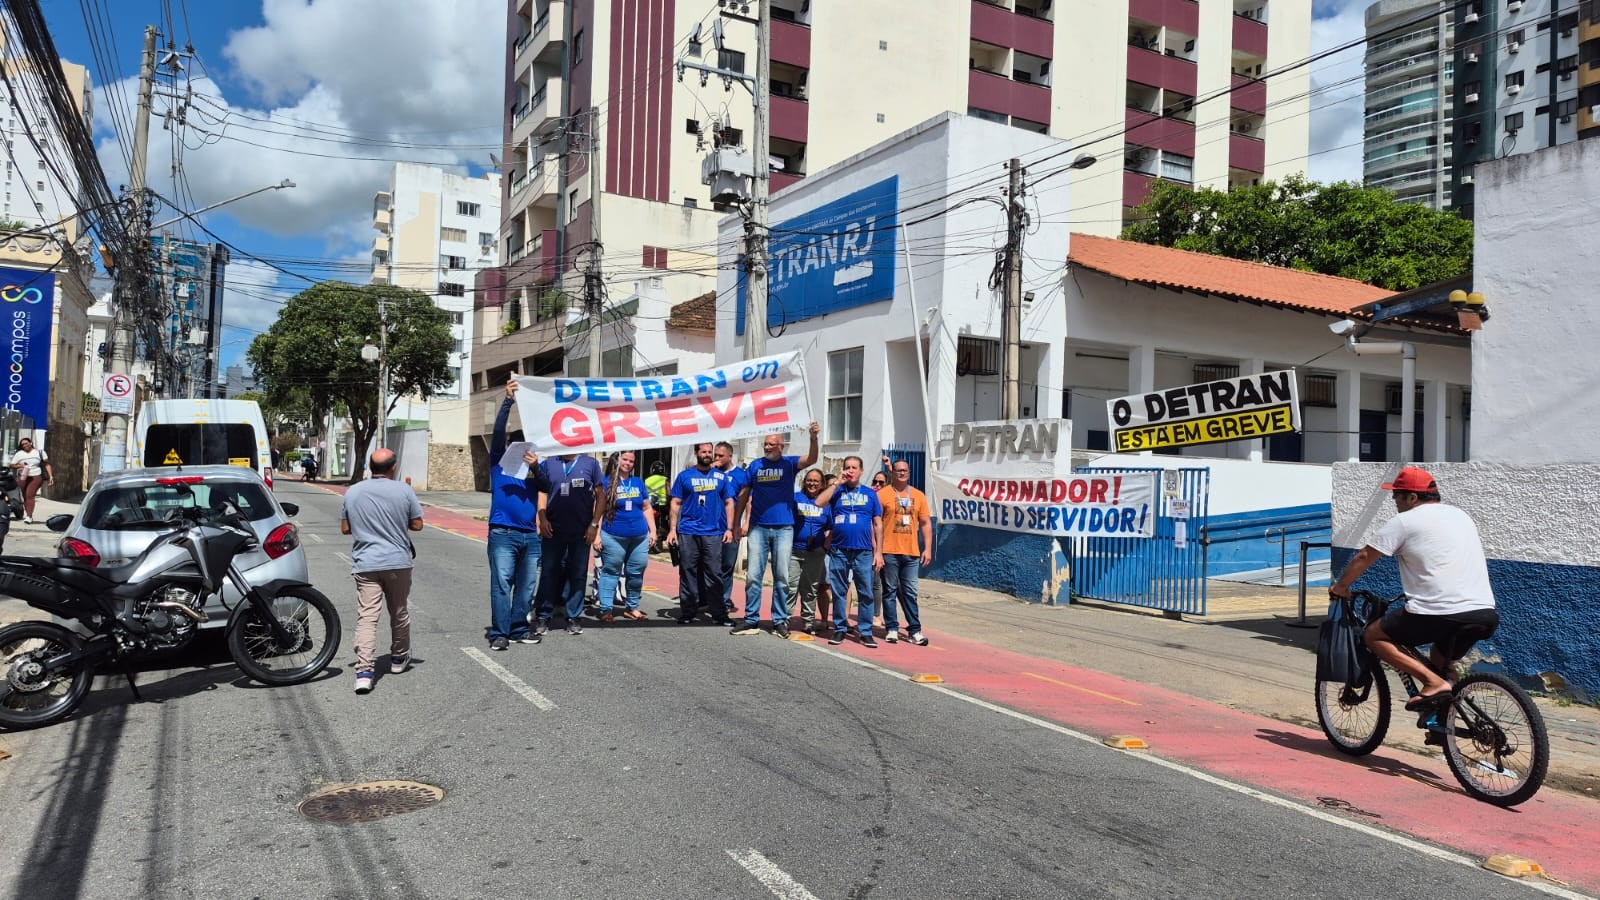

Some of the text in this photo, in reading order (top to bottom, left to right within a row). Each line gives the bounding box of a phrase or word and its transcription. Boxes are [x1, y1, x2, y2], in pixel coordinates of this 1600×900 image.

[767, 216, 876, 284] ETRAN RJ
[554, 360, 780, 403] DETRAN em
[1113, 371, 1291, 426] O DETRAN
[549, 386, 789, 447] GREVE
[1118, 410, 1287, 449] ESTÁ EM GREVE
[953, 422, 1059, 456] DETRAN
[957, 476, 1122, 505] GOVERNADOR!
[942, 499, 1009, 526] RESPEITE
[1028, 503, 1149, 534] SERVIDOR!
